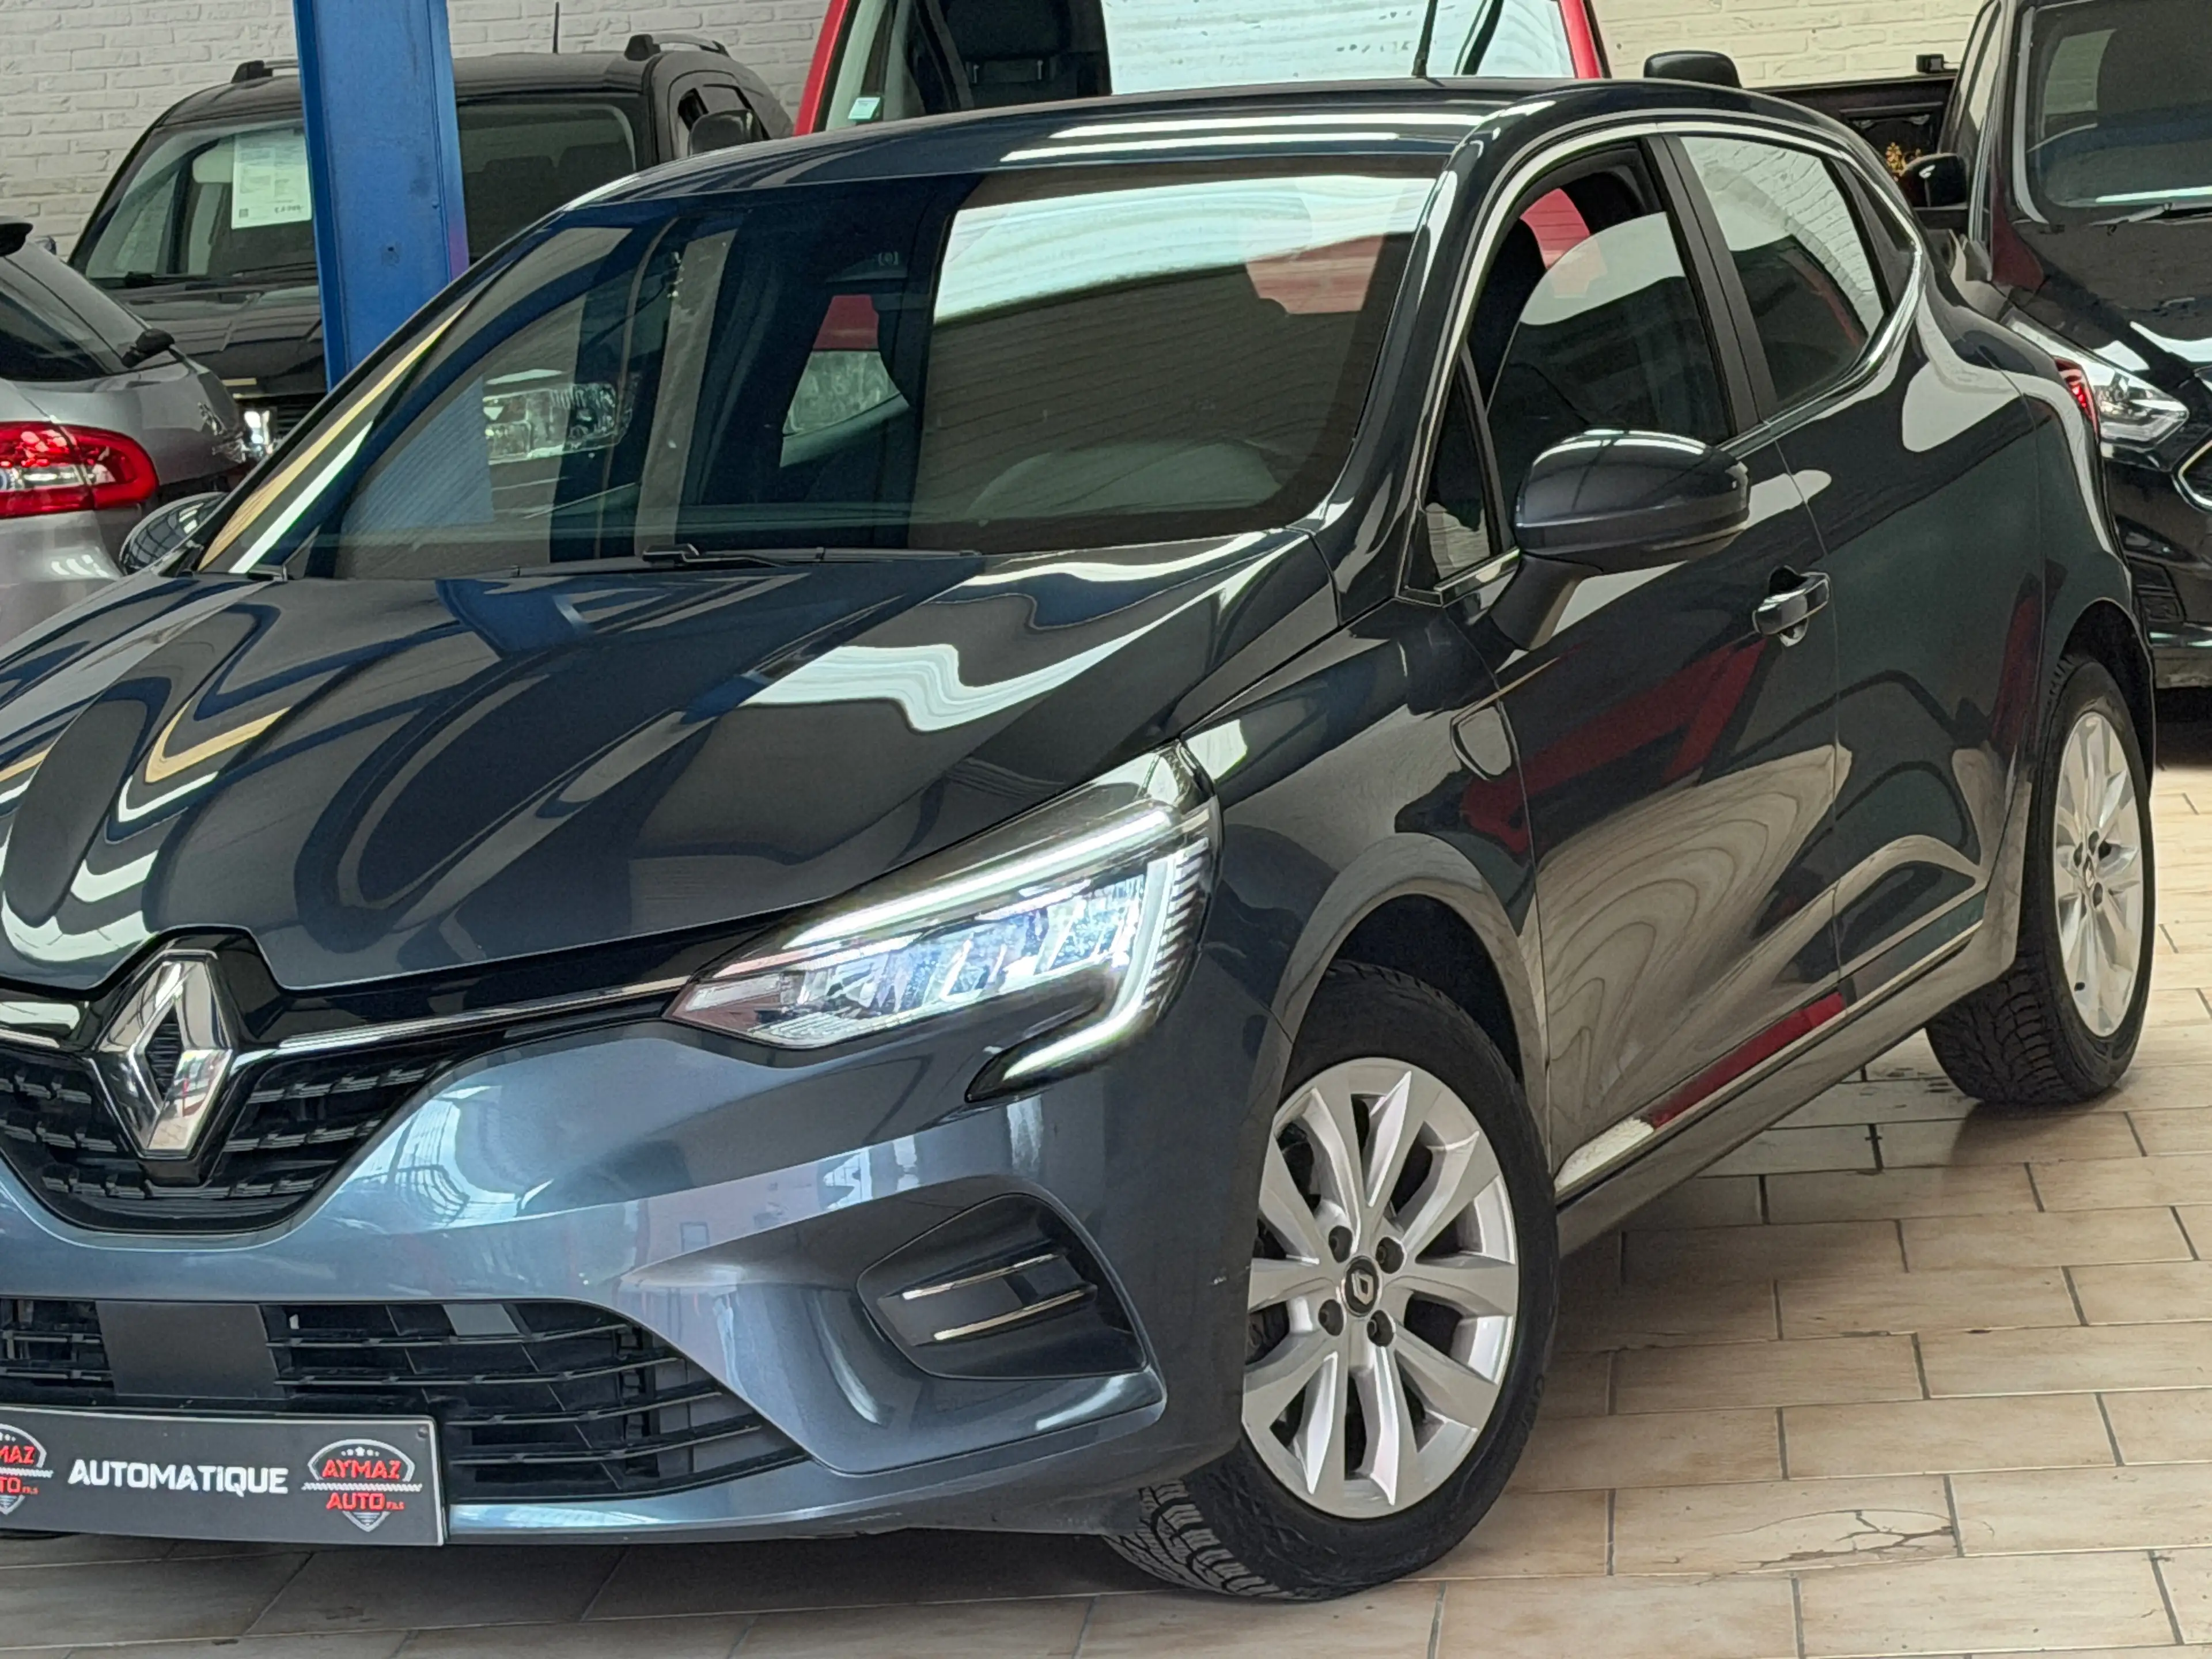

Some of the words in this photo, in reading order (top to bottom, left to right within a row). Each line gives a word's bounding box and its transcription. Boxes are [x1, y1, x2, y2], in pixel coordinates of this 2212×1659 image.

[67, 1459, 289, 1497] AUTOMATIQUE
[321, 1459, 402, 1479] AYMAZ
[326, 1492, 385, 1510] AUTO
